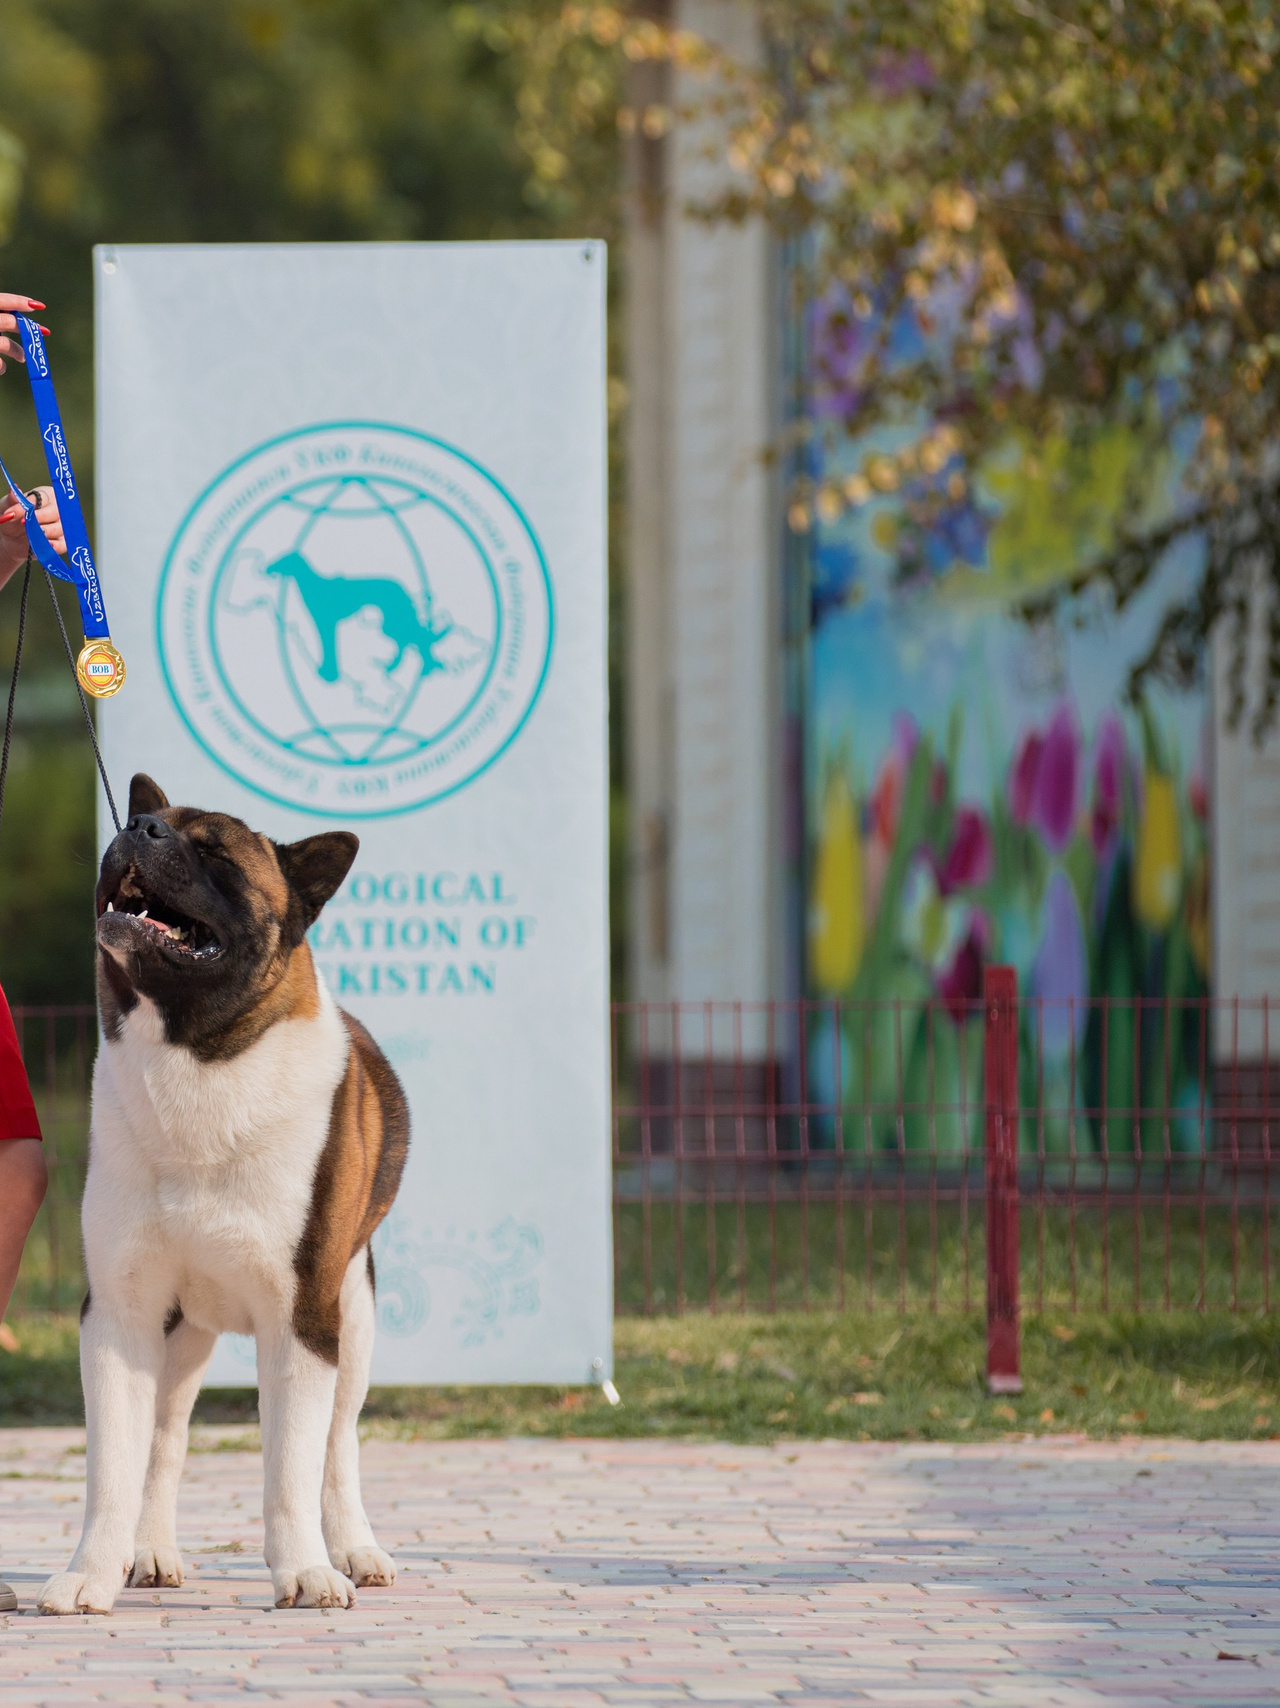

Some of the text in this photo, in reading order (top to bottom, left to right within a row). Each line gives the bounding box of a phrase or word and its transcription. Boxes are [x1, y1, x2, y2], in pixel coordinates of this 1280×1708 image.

[54, 424, 76, 500] UZBEKISTAN
[82, 547, 104, 622] UZBEKISTAN
[91, 664, 110, 674] BOB
[327, 871, 517, 907] OGICAL
[307, 916, 536, 951] RATION OF
[324, 961, 497, 995] KISTAN
